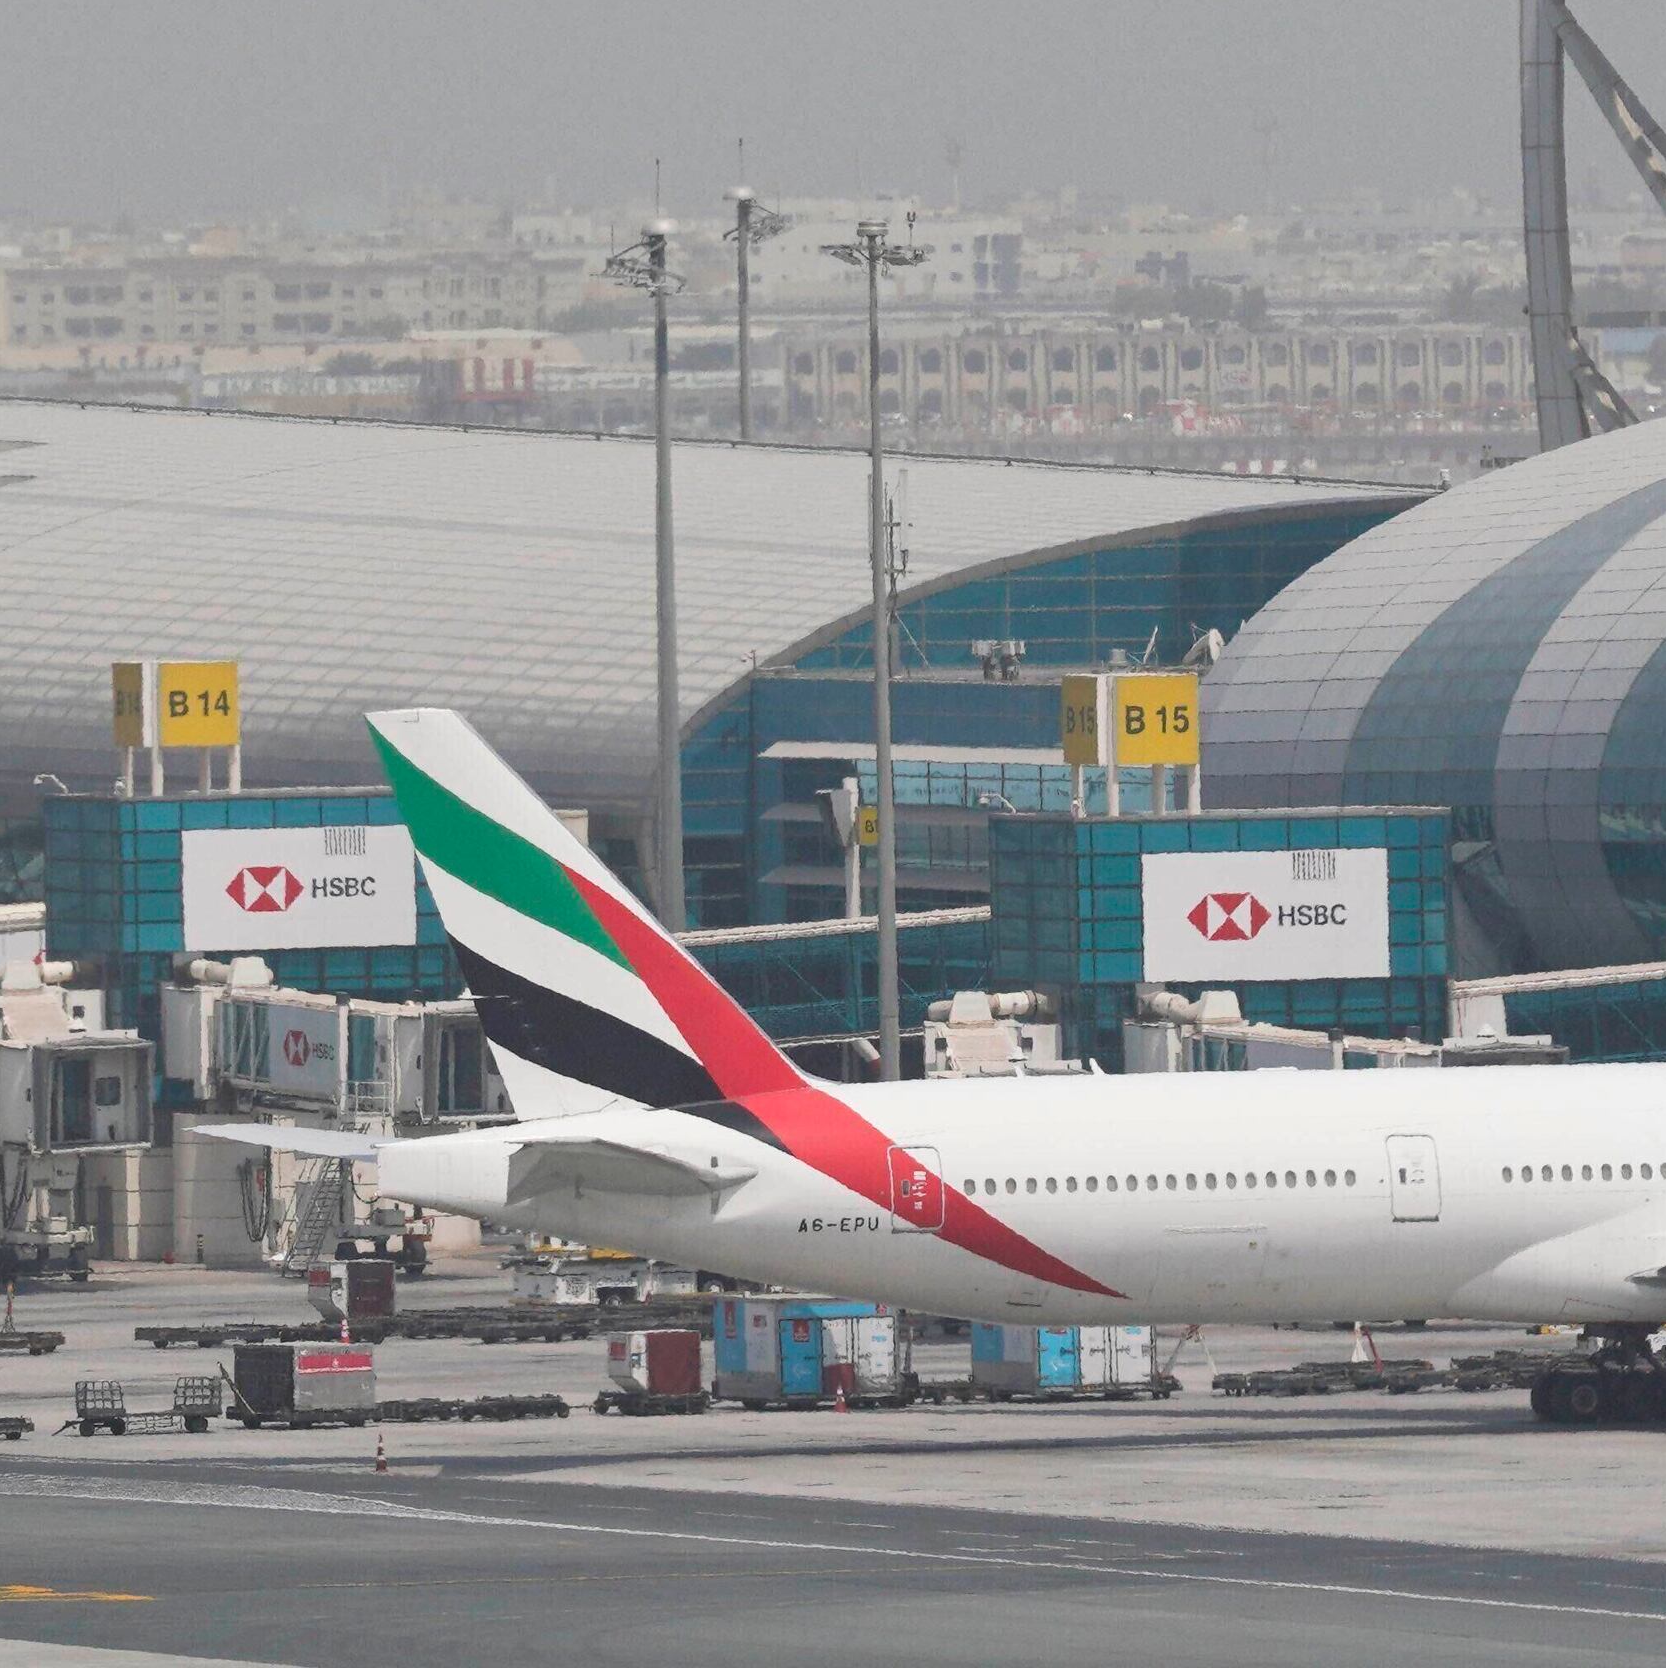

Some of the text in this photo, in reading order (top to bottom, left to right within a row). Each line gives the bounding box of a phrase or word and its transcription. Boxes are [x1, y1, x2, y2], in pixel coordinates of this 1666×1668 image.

[169, 689, 230, 717] B 14
[1125, 705, 1189, 734] B 15
[312, 876, 376, 898] HSBC
[1278, 904, 1347, 926] HSBC
[798, 1217, 879, 1233] A6-EPU
